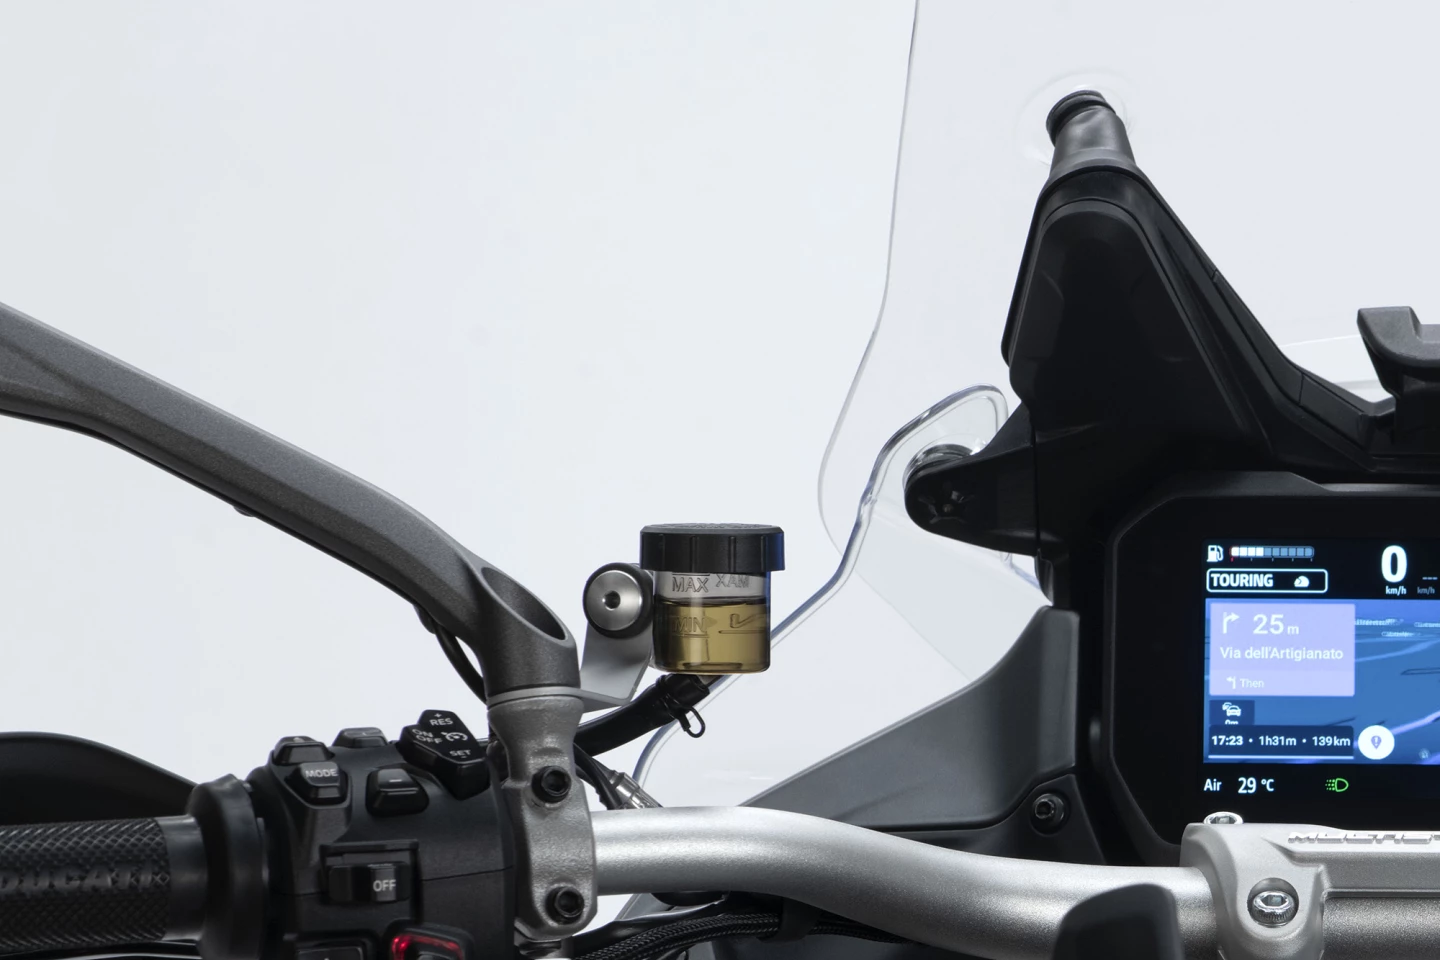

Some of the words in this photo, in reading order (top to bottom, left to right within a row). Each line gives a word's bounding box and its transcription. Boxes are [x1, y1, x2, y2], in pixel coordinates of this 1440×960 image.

[1381, 545, 1408, 583] 0
[672, 577, 709, 593] MAX
[1211, 573, 1274, 588] TOURING
[1385, 586, 1407, 595] km/h
[1417, 586, 1436, 595] km/h
[1253, 614, 1284, 635] 25
[1287, 625, 1299, 635] m
[1220, 646, 1242, 659] Via
[1245, 646, 1344, 662] dell'Artigianato
[1240, 678, 1264, 688] Then
[429, 718, 453, 726] RES
[412, 729, 434, 738] ON
[416, 735, 443, 744] OFF
[1212, 735, 1243, 746] 17:23
[1259, 735, 1297, 746] 1h31m
[449, 749, 471, 757] SET
[305, 768, 338, 778] MODE
[1203, 778, 1222, 792] Air
[1238, 777, 1257, 793] 29
[373, 879, 397, 892] OFF
